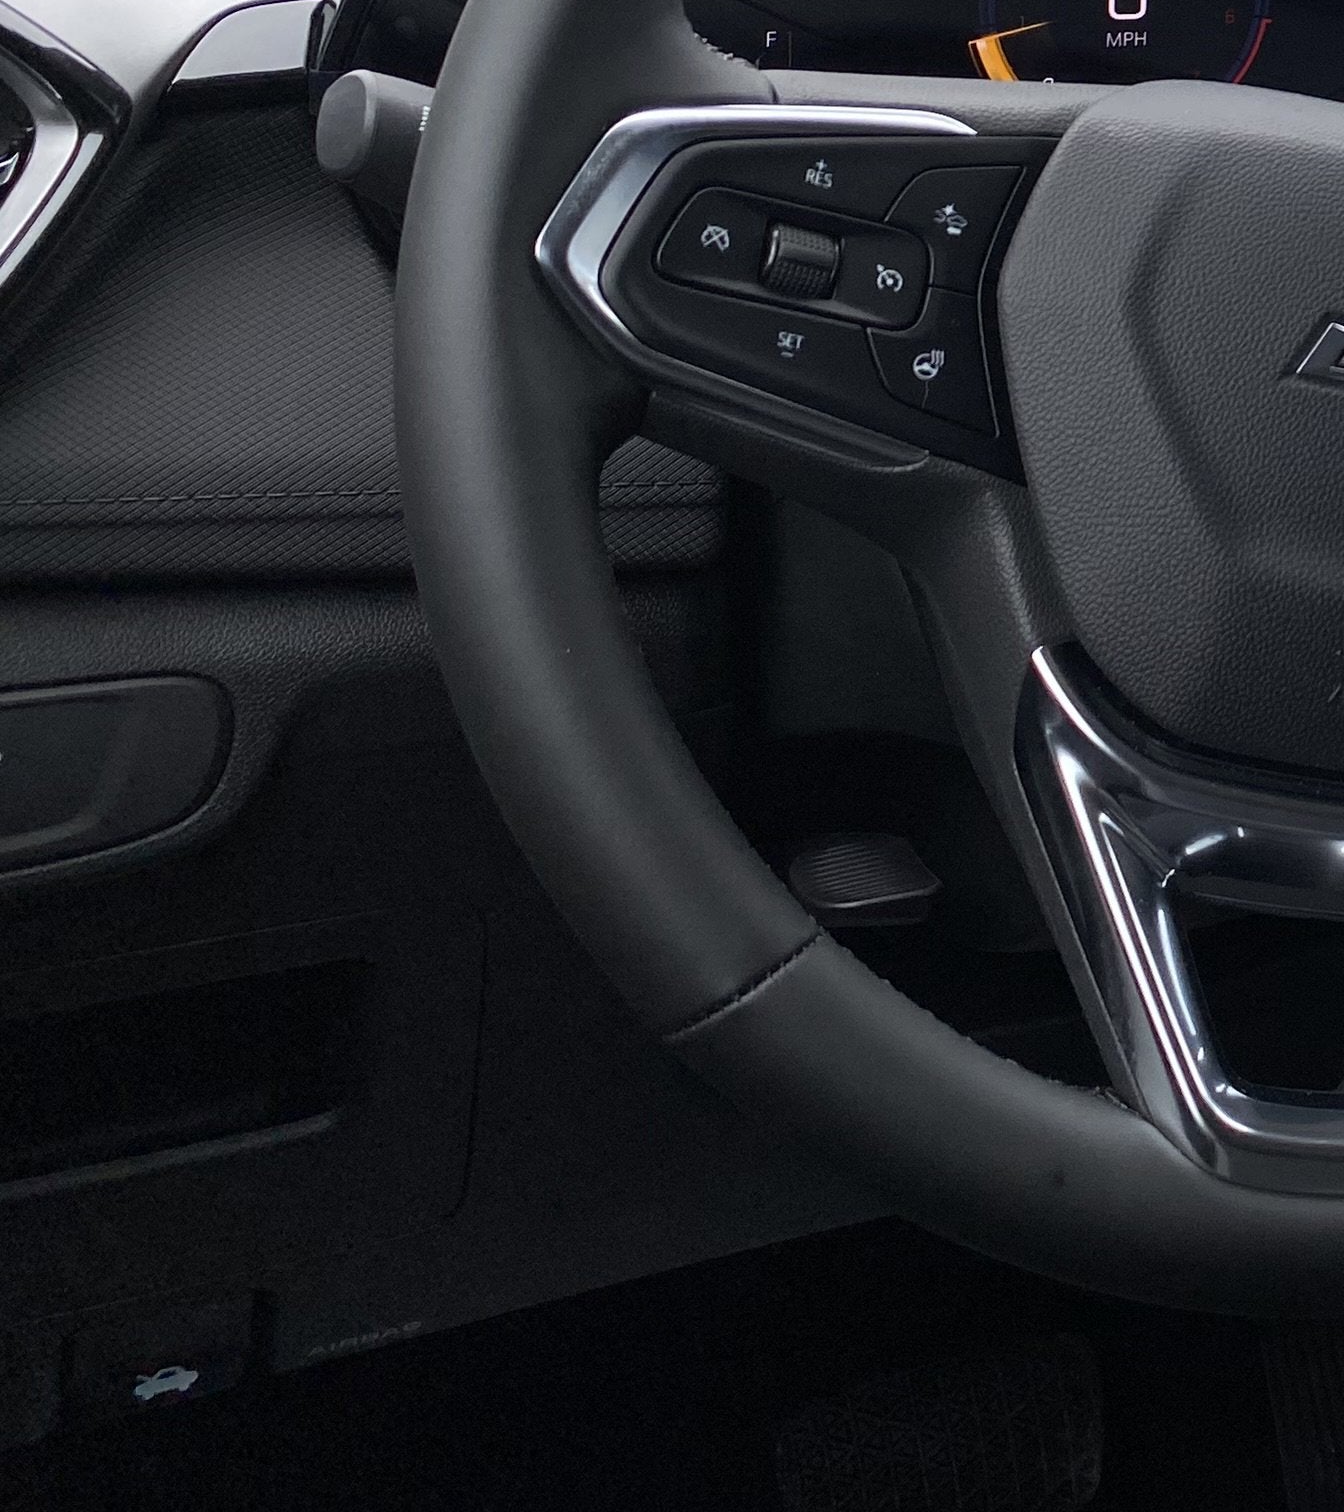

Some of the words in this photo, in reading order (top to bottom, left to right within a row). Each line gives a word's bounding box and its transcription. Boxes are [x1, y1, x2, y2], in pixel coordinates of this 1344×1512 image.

[1224, 7, 1235, 24] 6
[766, 31, 777, 48] F
[1105, 31, 1147, 48] MPH
[805, 168, 833, 188] RES
[777, 331, 805, 350] SET
